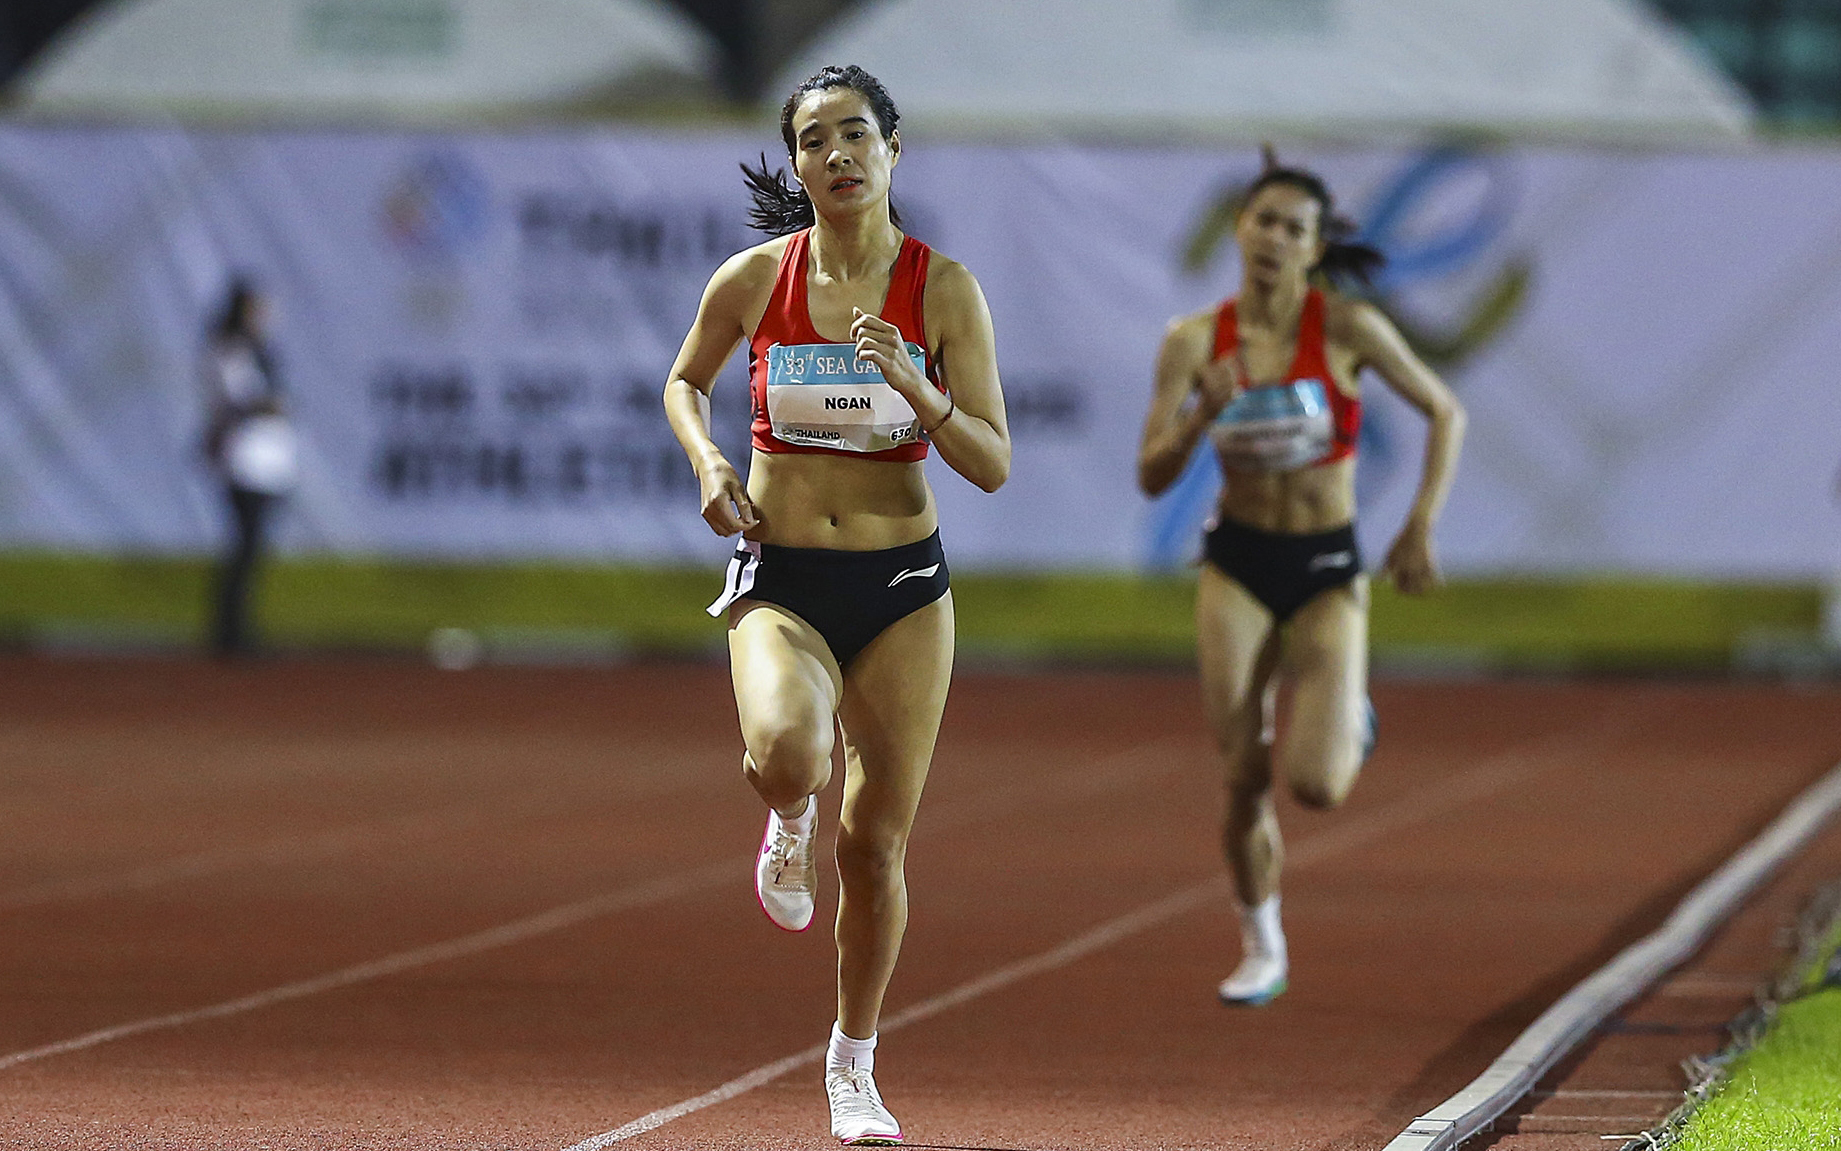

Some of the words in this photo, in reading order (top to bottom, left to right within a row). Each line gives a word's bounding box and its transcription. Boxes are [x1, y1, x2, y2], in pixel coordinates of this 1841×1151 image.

[816, 356, 848, 375] SEA
[853, 357, 882, 375] GA
[825, 397, 871, 410] NGAN
[794, 429, 840, 440] THAILAND
